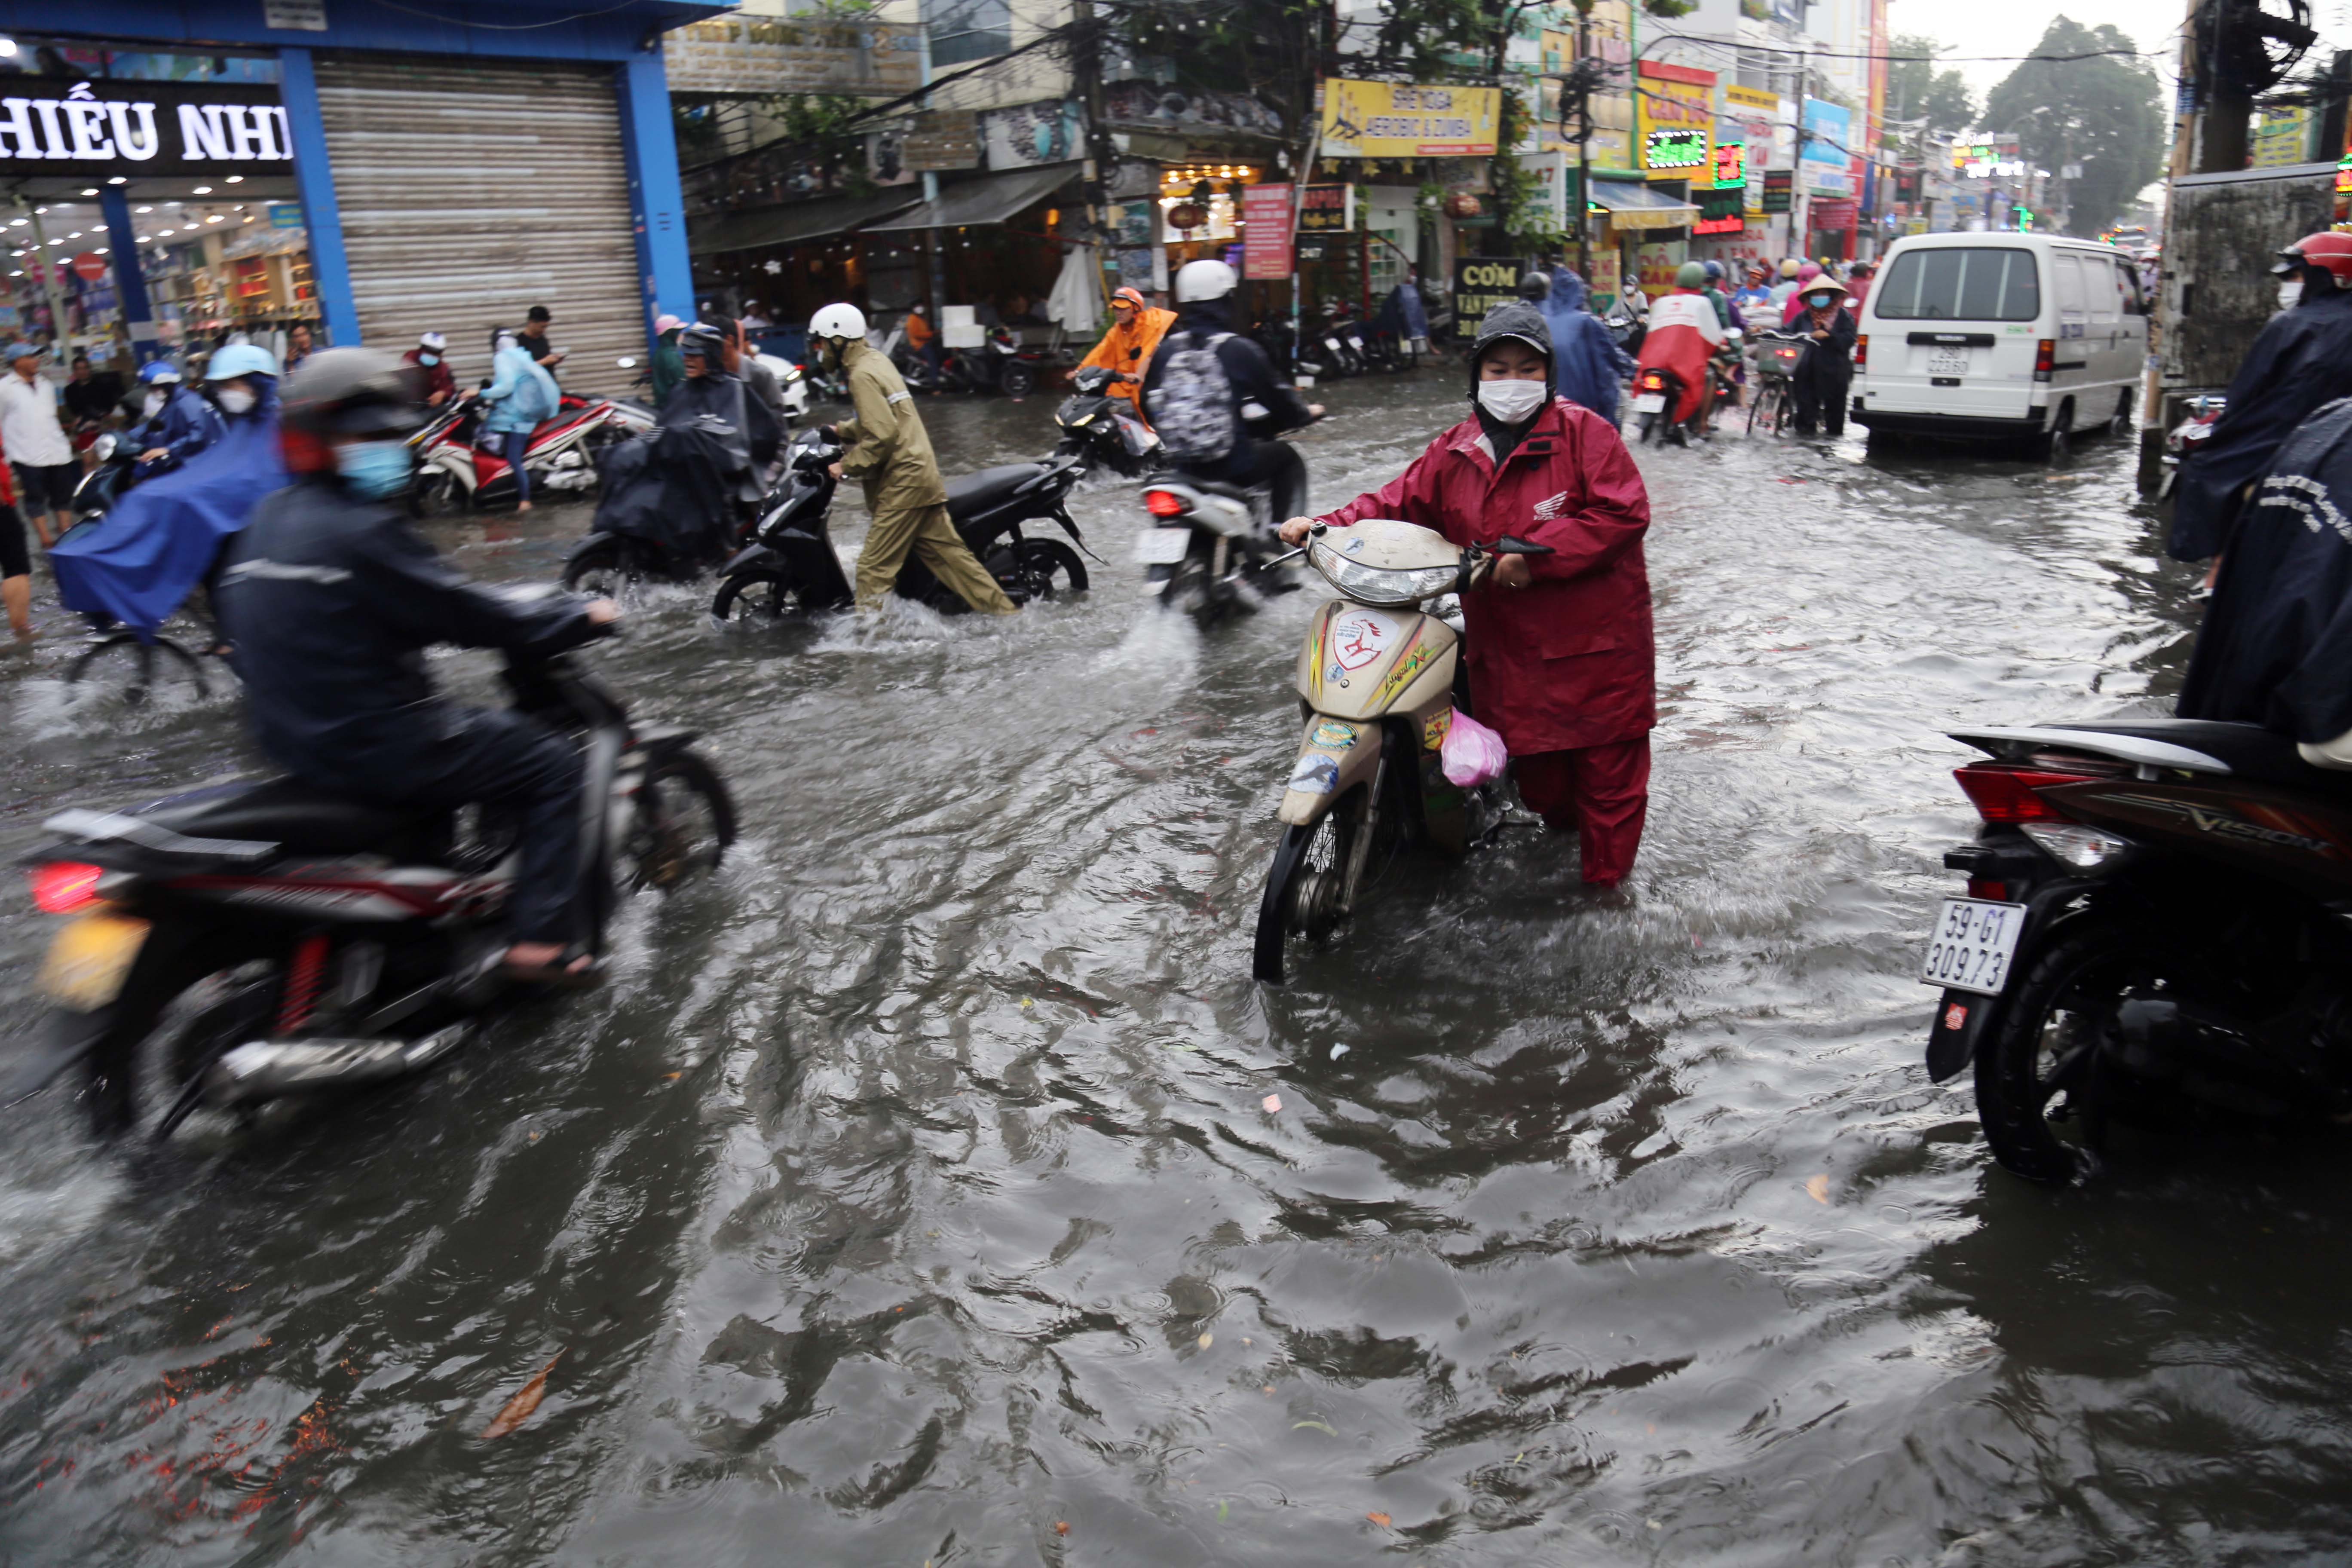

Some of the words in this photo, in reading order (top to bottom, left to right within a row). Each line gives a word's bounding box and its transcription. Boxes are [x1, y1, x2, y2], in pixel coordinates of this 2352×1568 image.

[0, 82, 159, 161] HIẾU
[1462, 262, 1517, 287] CƠM
[1946, 904, 2007, 945] 59-G1
[1927, 943, 2003, 987] 309.73
